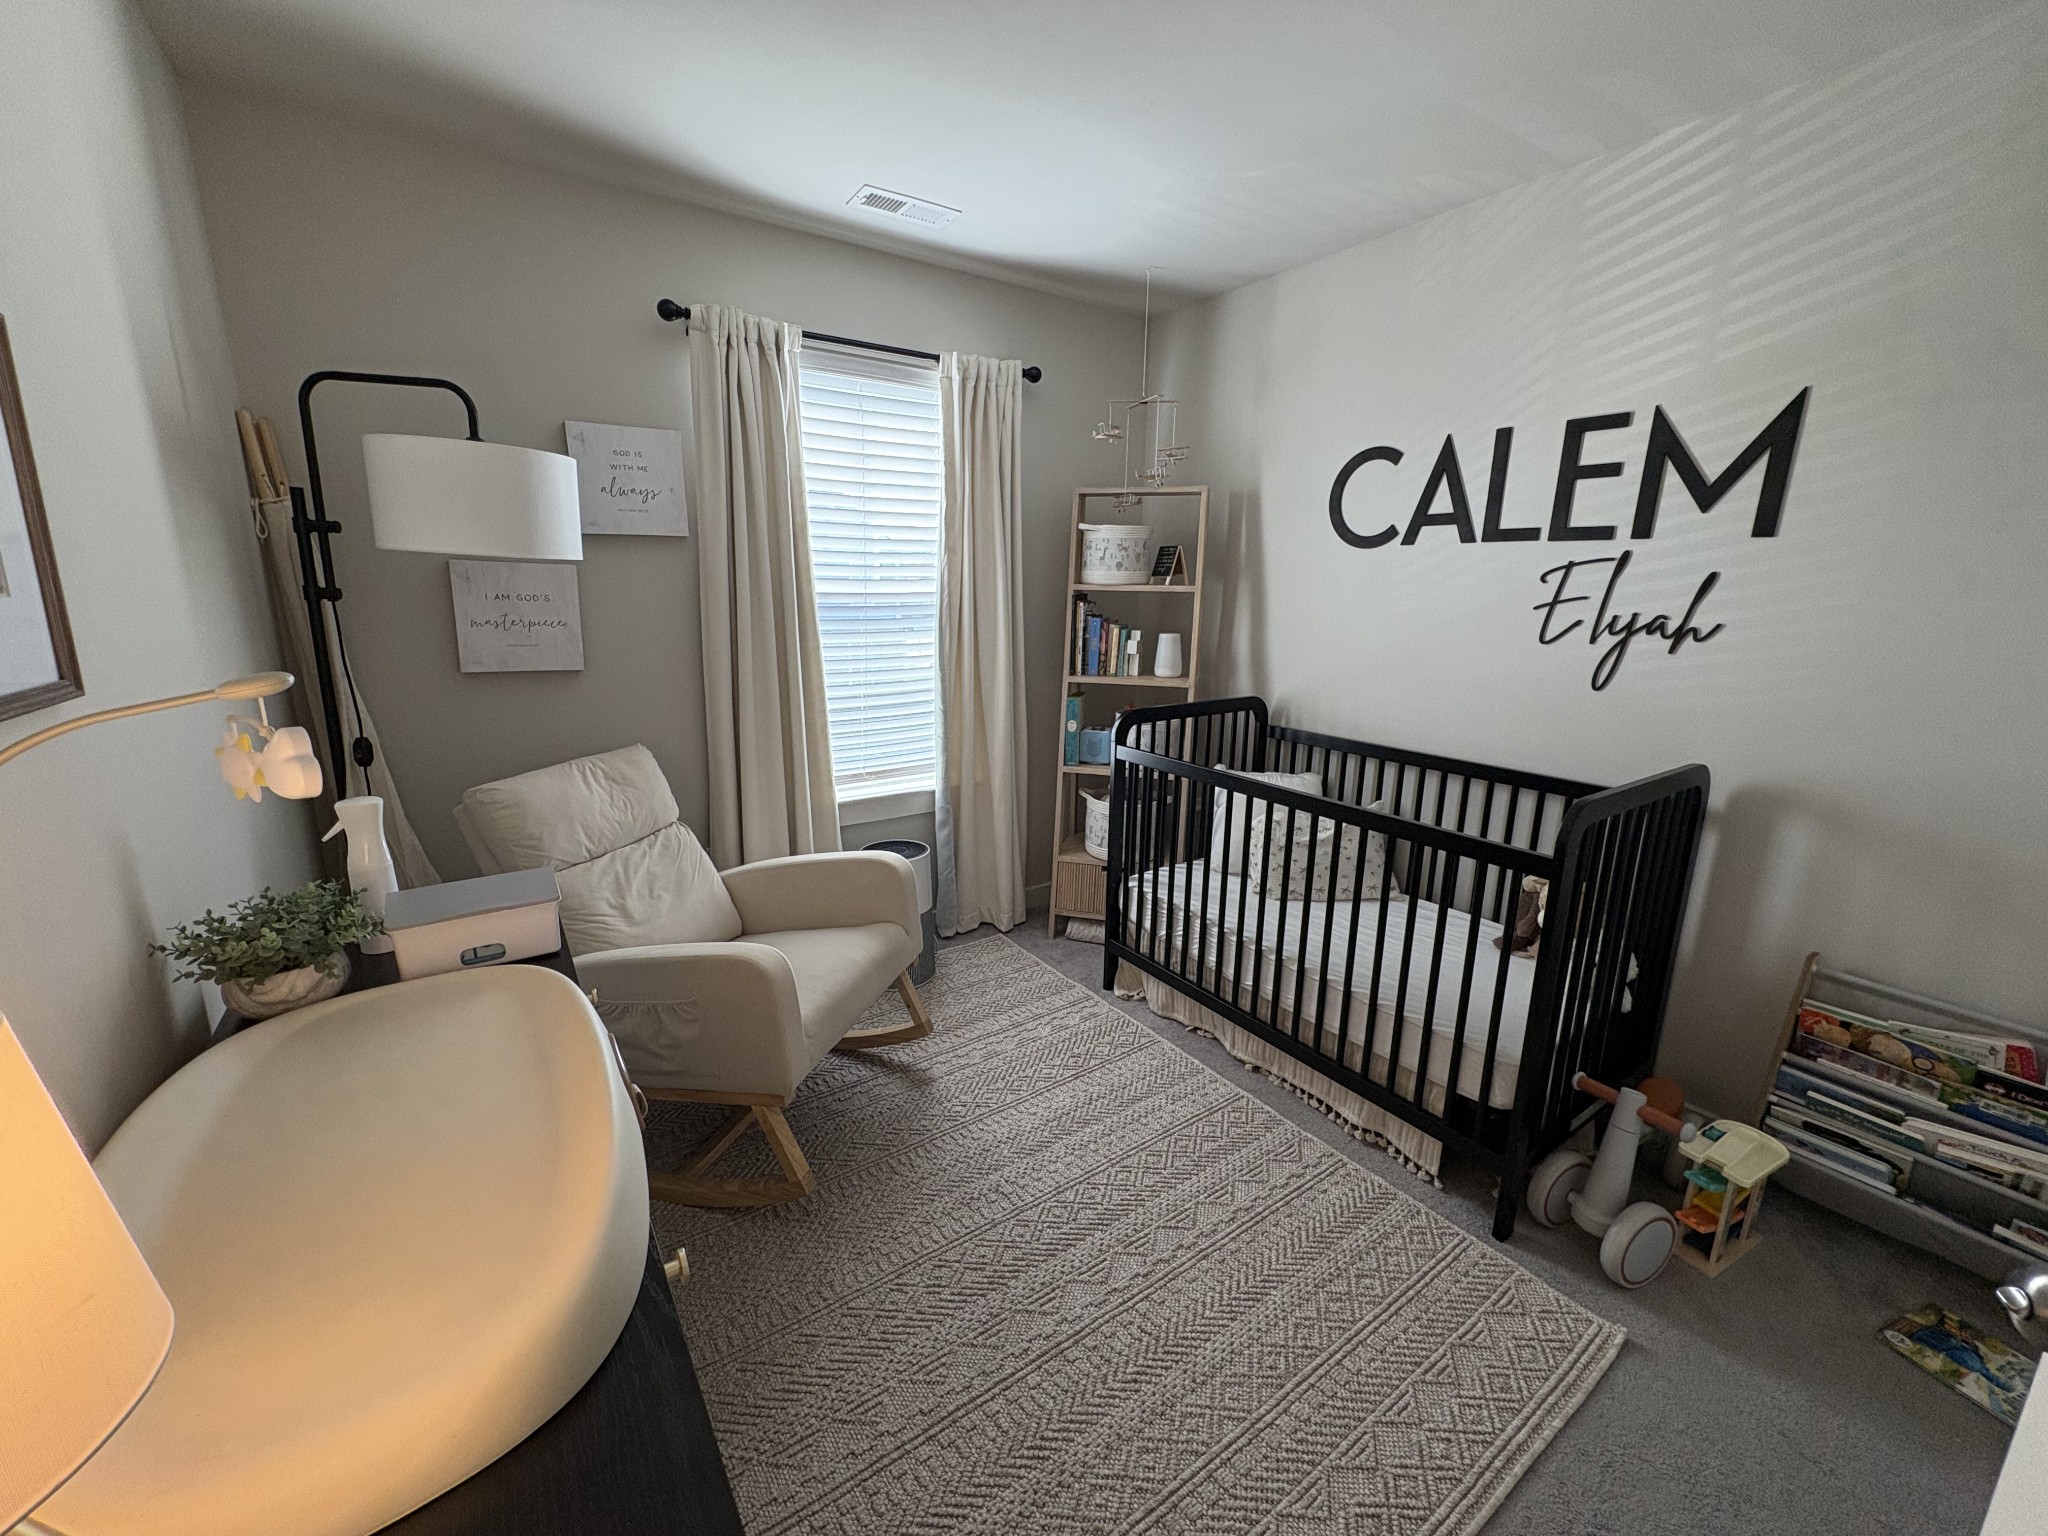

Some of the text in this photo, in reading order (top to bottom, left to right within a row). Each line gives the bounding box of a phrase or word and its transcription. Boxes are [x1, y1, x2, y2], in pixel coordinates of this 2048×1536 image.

[612, 449, 630, 458] GOD
[609, 463, 633, 471] WITH
[1329, 386, 1812, 549] CALEM
[600, 476, 662, 504] always
[493, 593, 511, 602] AM
[515, 593, 550, 603] GOD'S
[470, 612, 567, 633] masterpiece
[1533, 550, 1722, 692] Elyah
